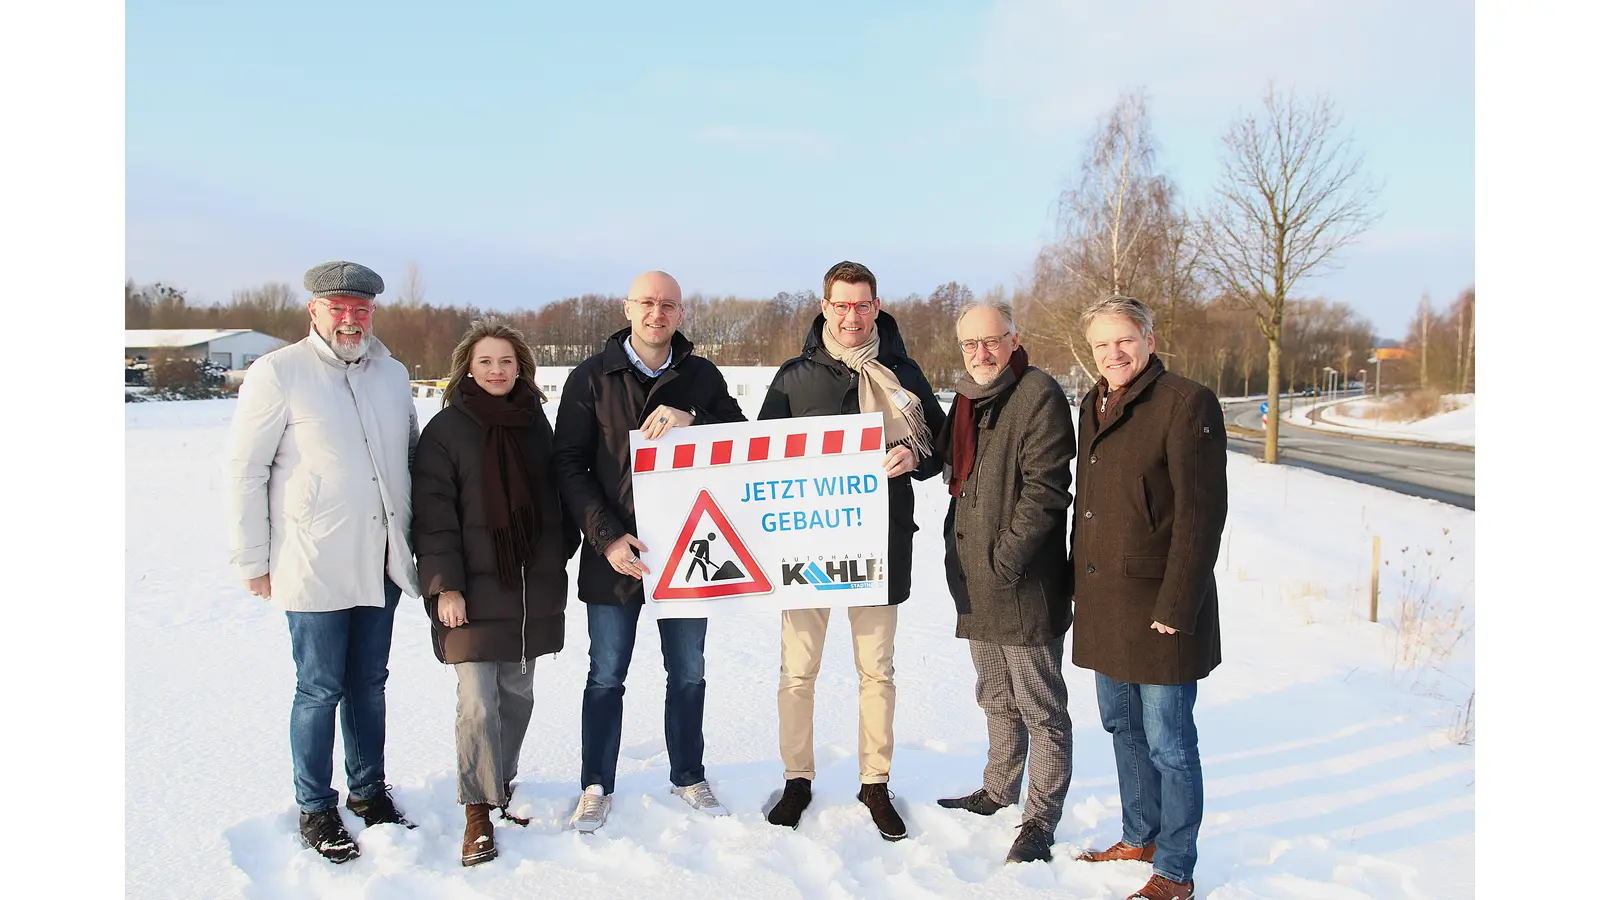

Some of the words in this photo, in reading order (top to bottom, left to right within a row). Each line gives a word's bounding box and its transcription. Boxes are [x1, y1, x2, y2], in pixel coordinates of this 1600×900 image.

[740, 479, 807, 502] JETZT
[813, 474, 878, 497] WIRD
[761, 507, 862, 532] GEBAUT!
